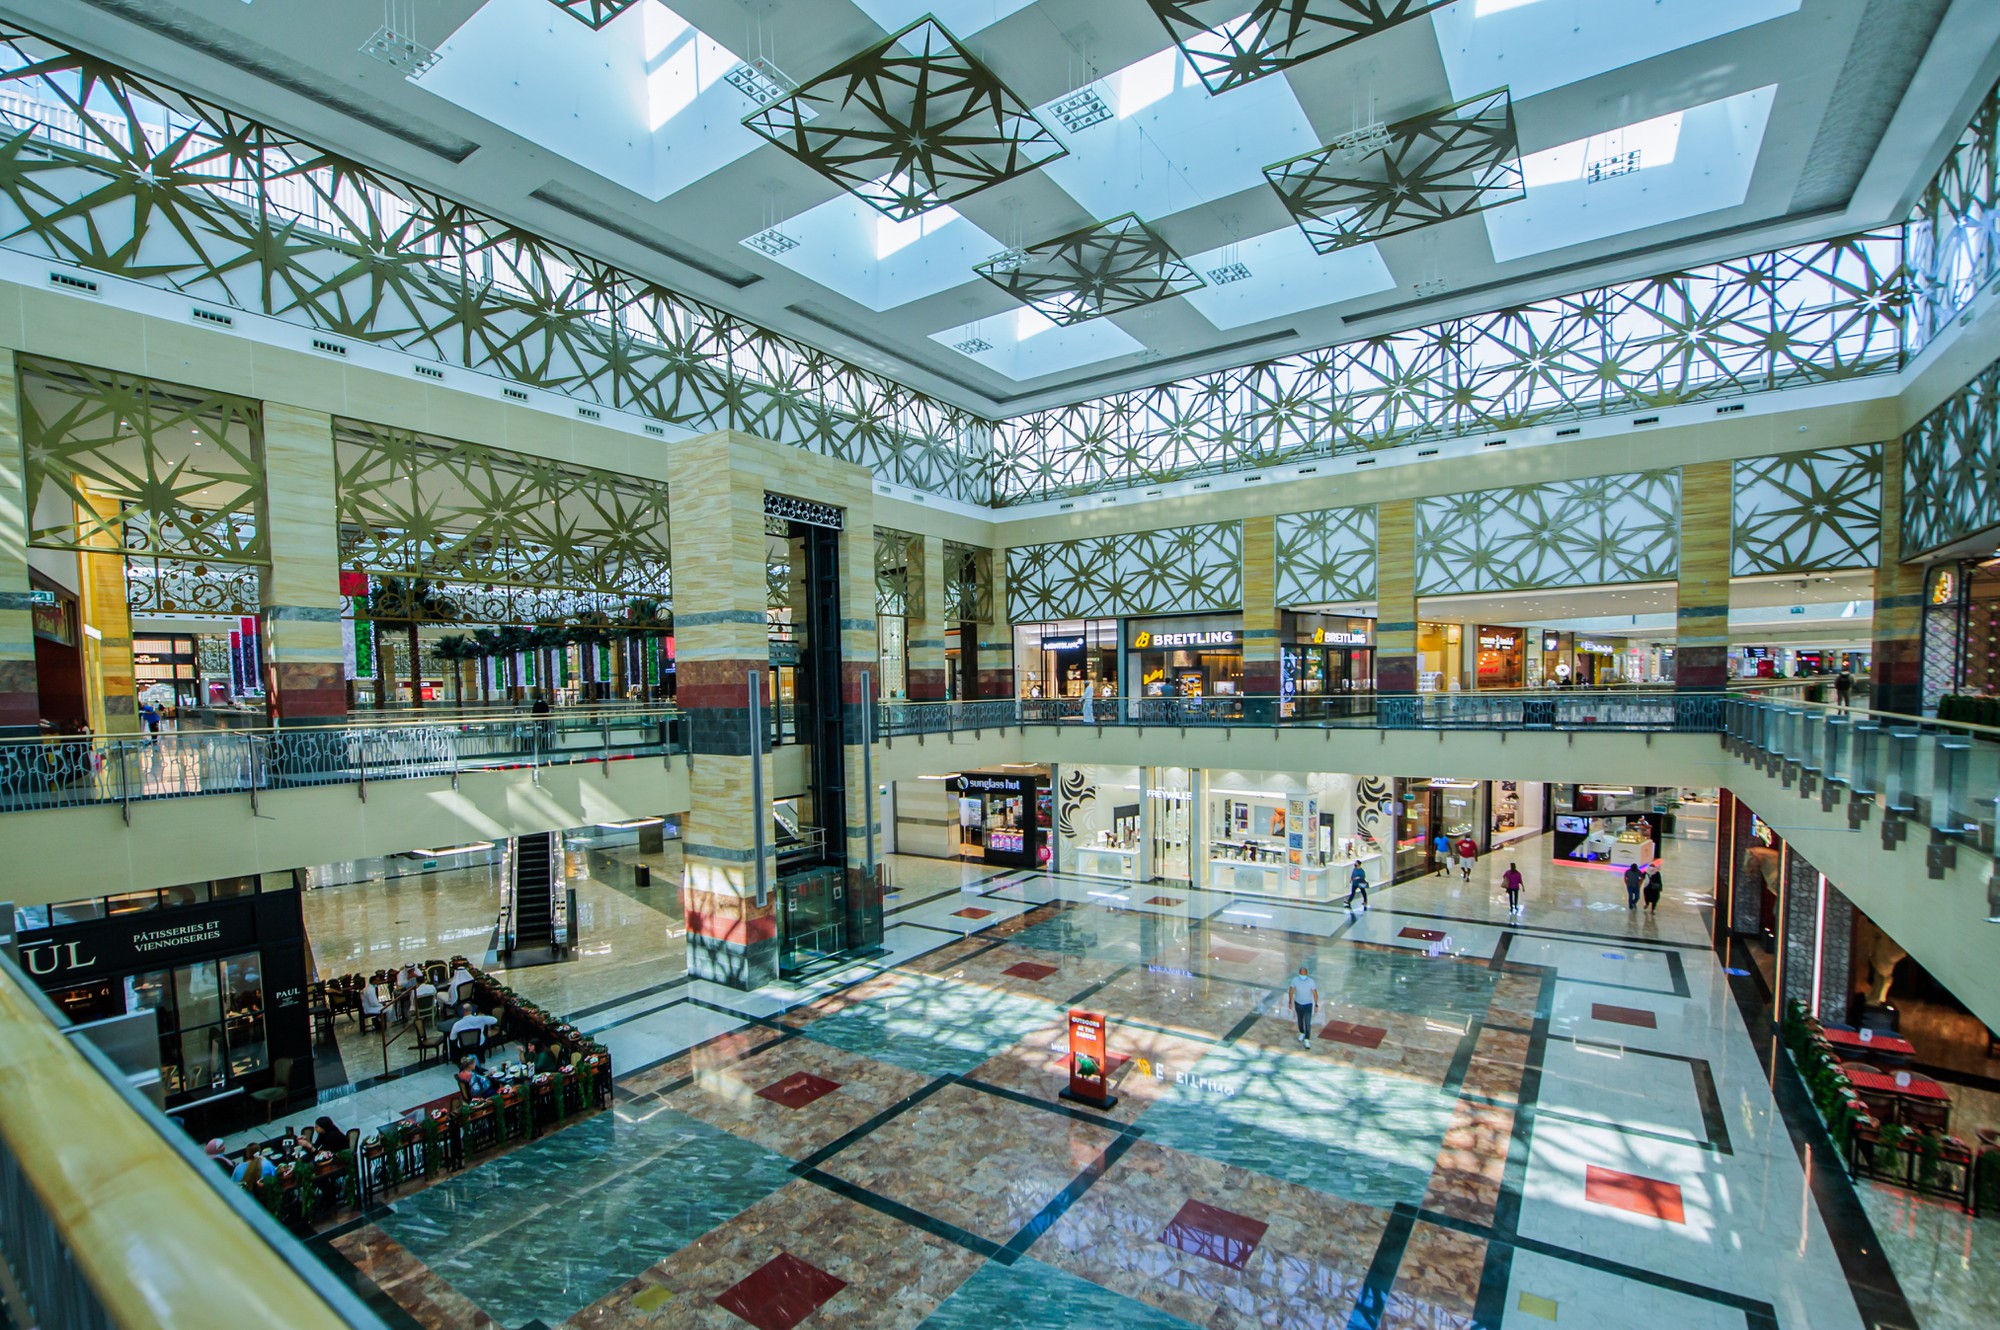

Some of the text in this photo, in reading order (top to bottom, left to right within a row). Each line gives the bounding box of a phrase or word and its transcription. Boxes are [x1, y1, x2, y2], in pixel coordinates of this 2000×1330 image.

[1153, 631, 1233, 646] BREITLING
[1324, 632, 1366, 645] BREITLING
[969, 778, 1020, 791] sunglass hut
[1146, 789, 1193, 800] FREYWILLE
[133, 920, 220, 943] PÂTISSERIES ET
[135, 930, 221, 952] VIENNOISERIES
[276, 987, 301, 999] PAUL
